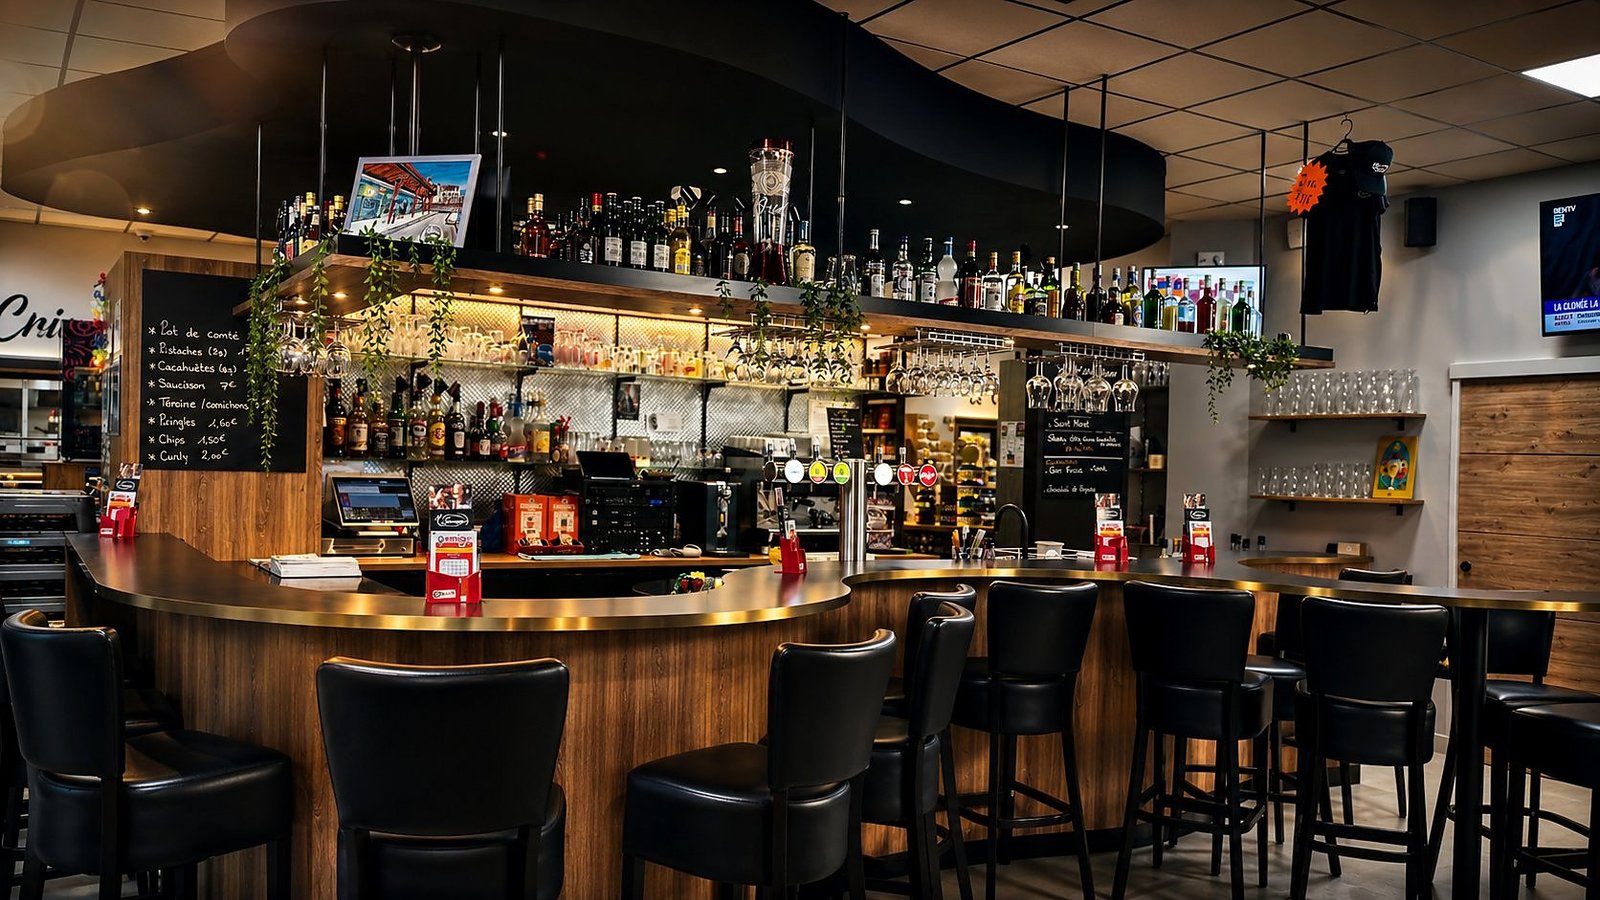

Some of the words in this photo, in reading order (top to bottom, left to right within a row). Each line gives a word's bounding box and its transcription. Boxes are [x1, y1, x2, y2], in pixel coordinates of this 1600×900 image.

[0, 294, 63, 342] Cri
[160, 319, 179, 336] Pot
[186, 327, 200, 338] de
[207, 330, 240, 341] comté
[159, 341, 203, 356] Pistaches
[157, 360, 215, 373] Cacahuètes
[159, 412, 196, 431] Pringles
[158, 434, 185, 447] Chips
[197, 434, 226, 446] 1,50€
[160, 450, 188, 465] Curly
[201, 448, 229, 461] 2,00€
